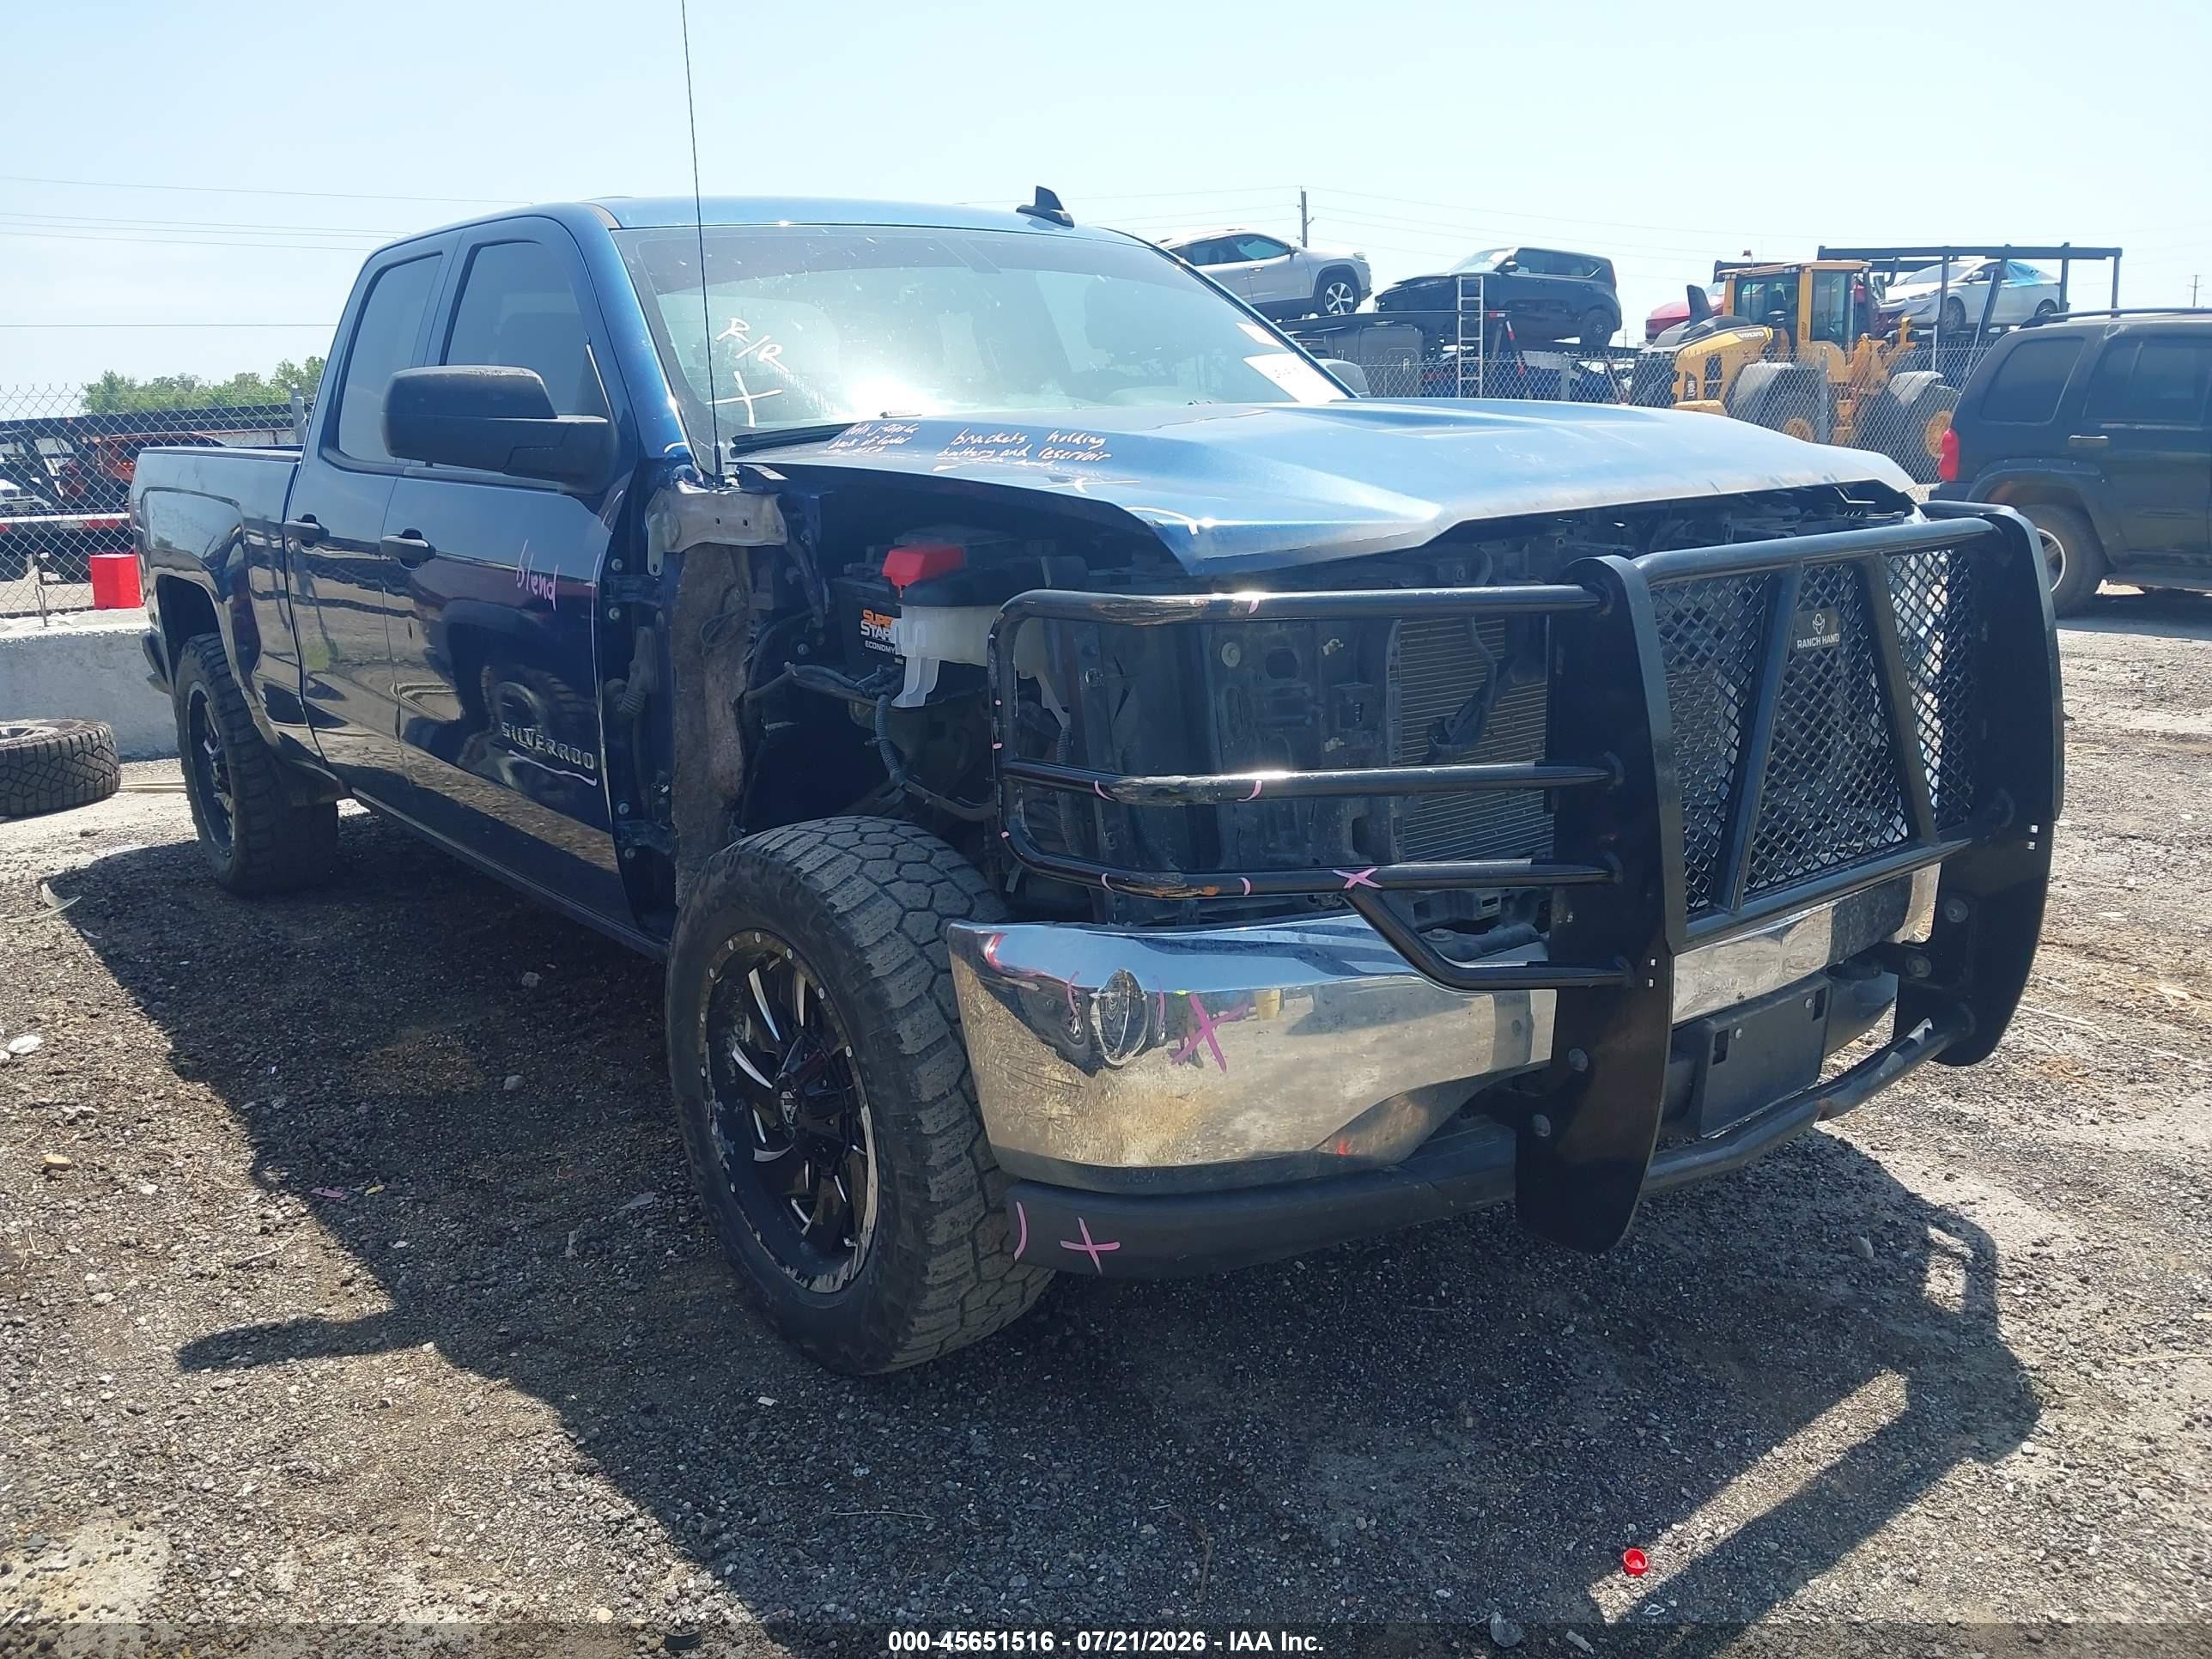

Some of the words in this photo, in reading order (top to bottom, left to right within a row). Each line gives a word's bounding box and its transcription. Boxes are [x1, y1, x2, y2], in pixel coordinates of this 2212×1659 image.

[951, 428, 1029, 446] brackets
[1046, 430, 1107, 451] holding
[1000, 444, 1033, 458] and
[516, 539, 558, 611] blend
[865, 640, 896, 653] ECONOMY
[1796, 635, 1821, 650] RANCH
[1821, 633, 1840, 645] HAND
[501, 722, 596, 770] SILVERADO
